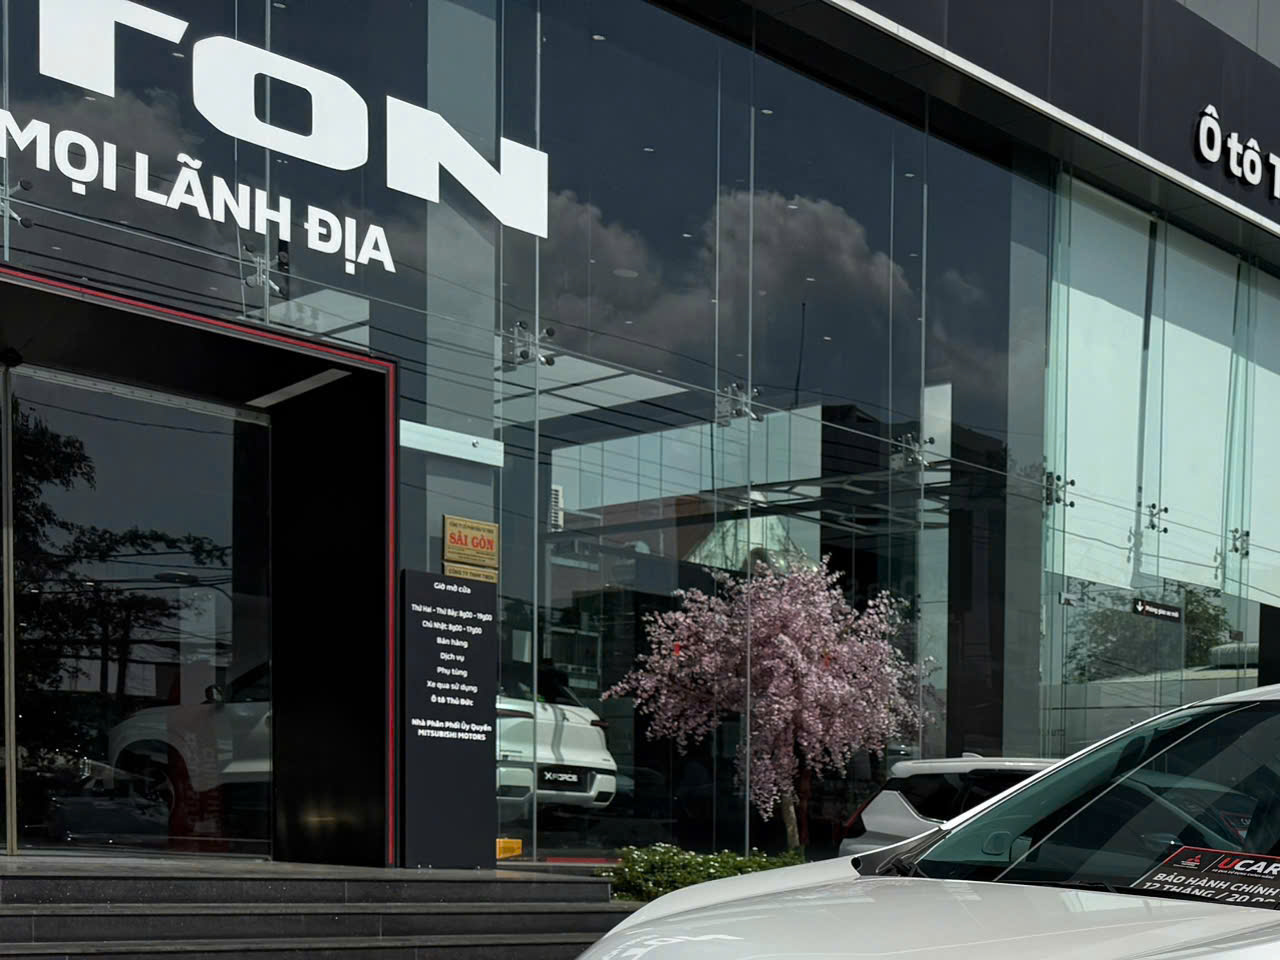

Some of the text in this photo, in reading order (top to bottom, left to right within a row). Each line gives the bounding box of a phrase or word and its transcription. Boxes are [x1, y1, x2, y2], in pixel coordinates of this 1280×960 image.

[1200, 104, 1222, 163] Ô
[1227, 132, 1262, 186] tô
[0, 109, 396, 275] MỌI LÃNH ĐỊA
[451, 638, 468, 648] hàng
[440, 652, 455, 661] Dịch
[426, 680, 436, 688] Xe
[436, 682, 450, 690] qua
[417, 729, 487, 741] MITSUBISHI MOTORS
[1153, 872, 1181, 884] BẢO
[1184, 876, 1228, 891] HÀNH
[1230, 881, 1280, 898] CHÍNH
